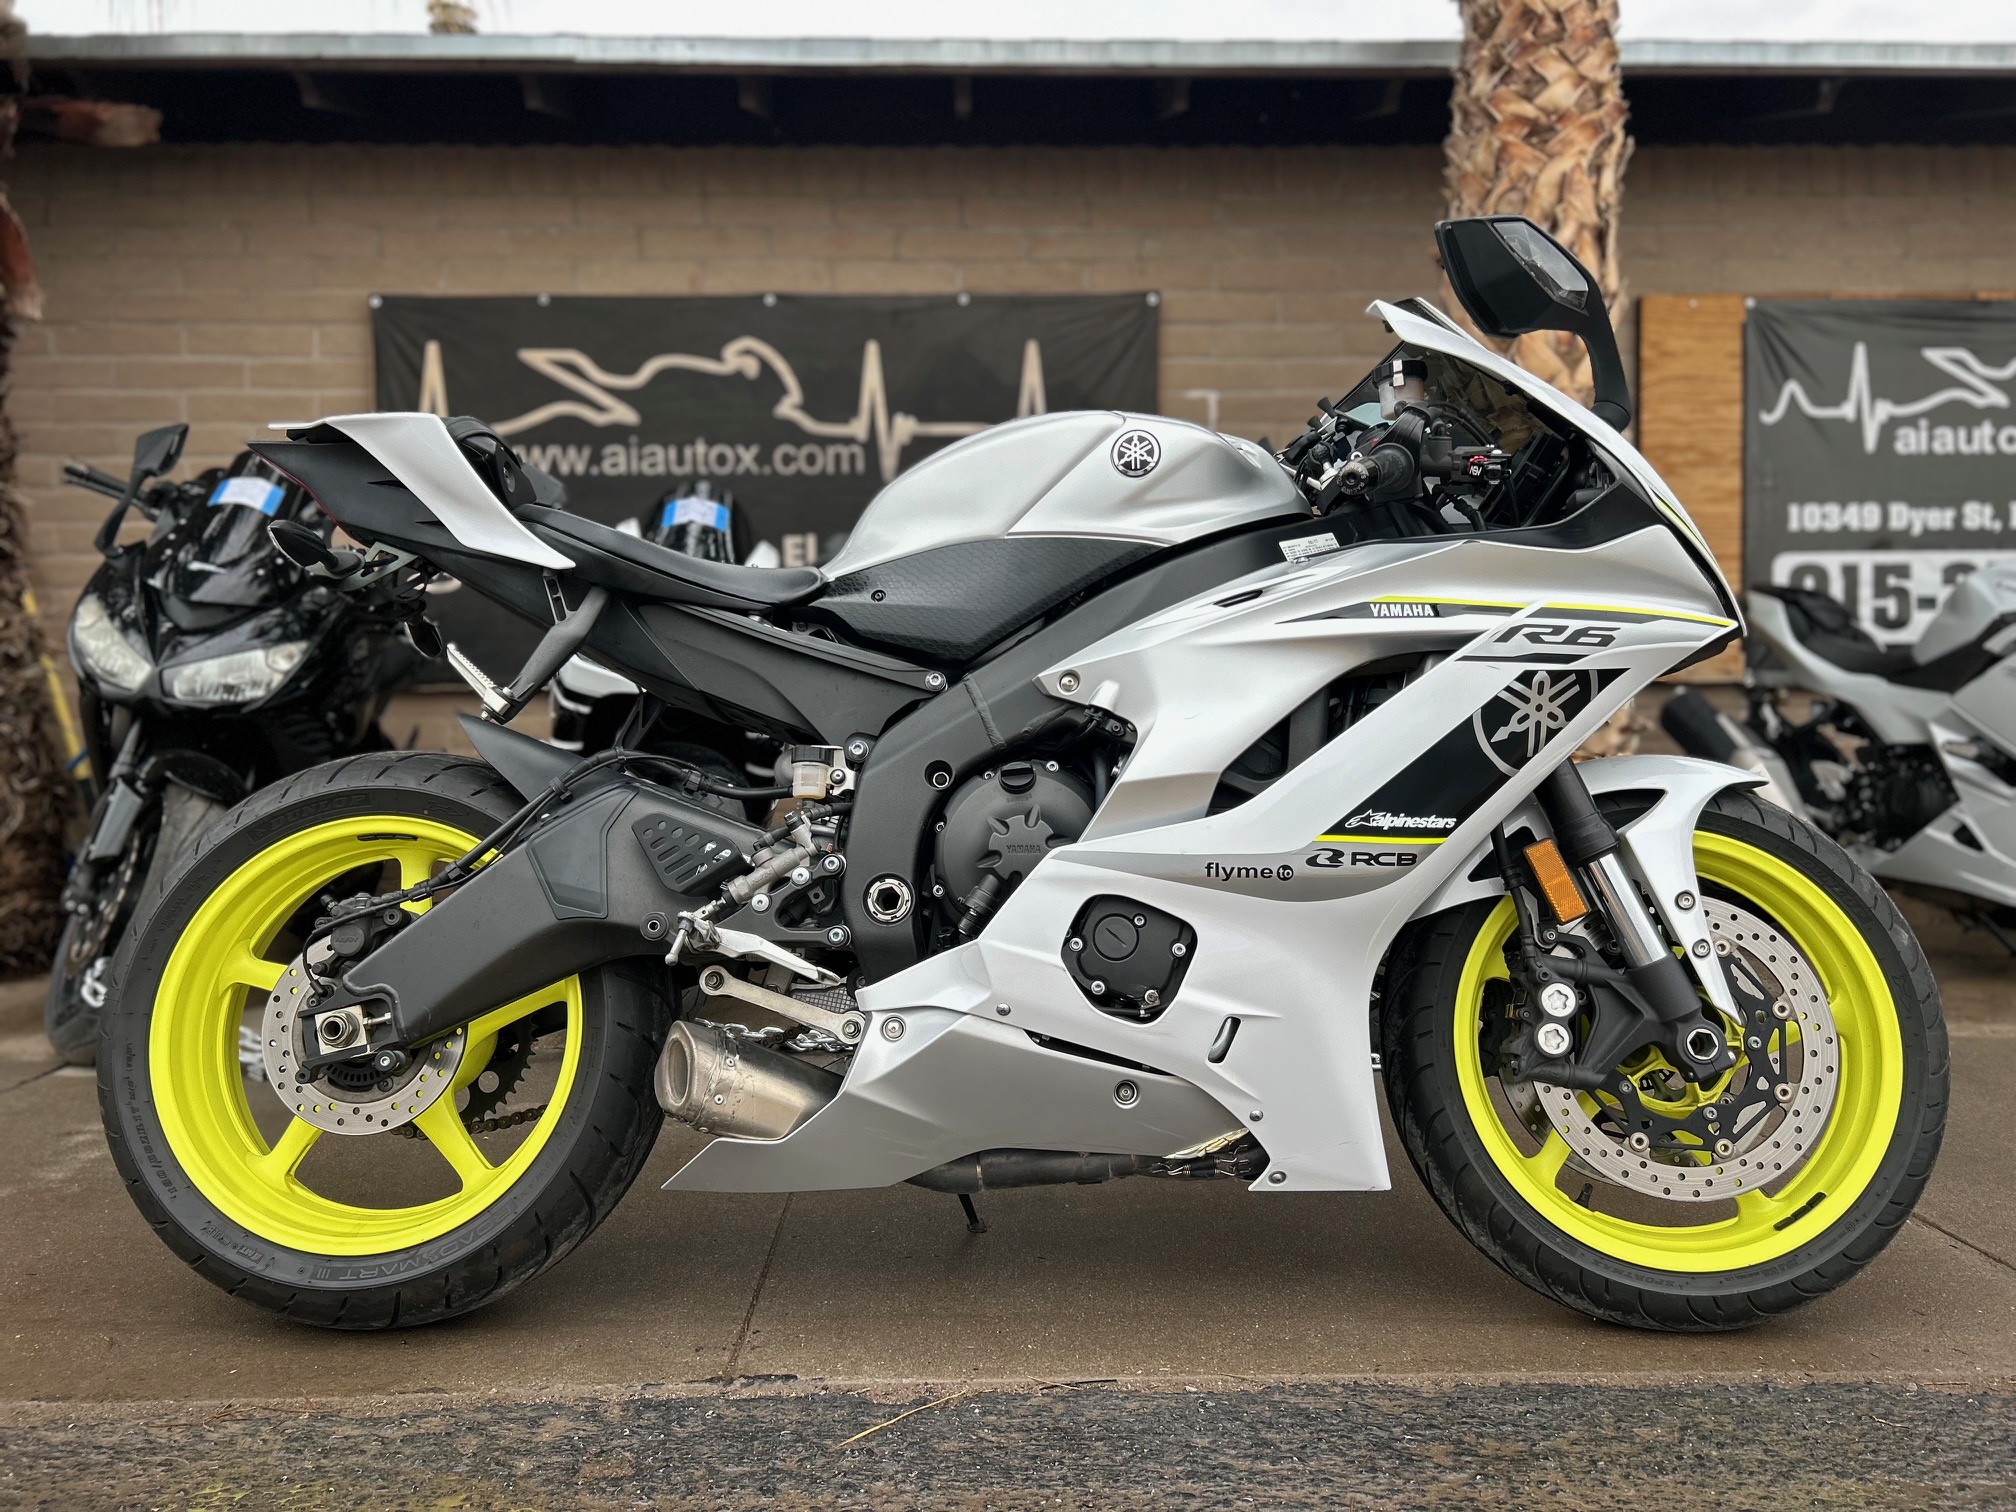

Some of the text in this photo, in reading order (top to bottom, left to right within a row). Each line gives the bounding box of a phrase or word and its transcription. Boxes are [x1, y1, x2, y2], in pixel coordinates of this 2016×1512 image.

[1786, 501, 1882, 532] 10349
[1888, 502, 1958, 536] Dyer
[1961, 500, 2003, 534] St,
[1369, 603, 1435, 617] YAMAHA
[1493, 623, 1621, 647] R6
[1372, 811, 1457, 830] alpinestars
[1005, 844, 1042, 854] YAMAHA
[1350, 852, 1418, 867] RCB
[339, 1205, 513, 1280] ROADSMART
